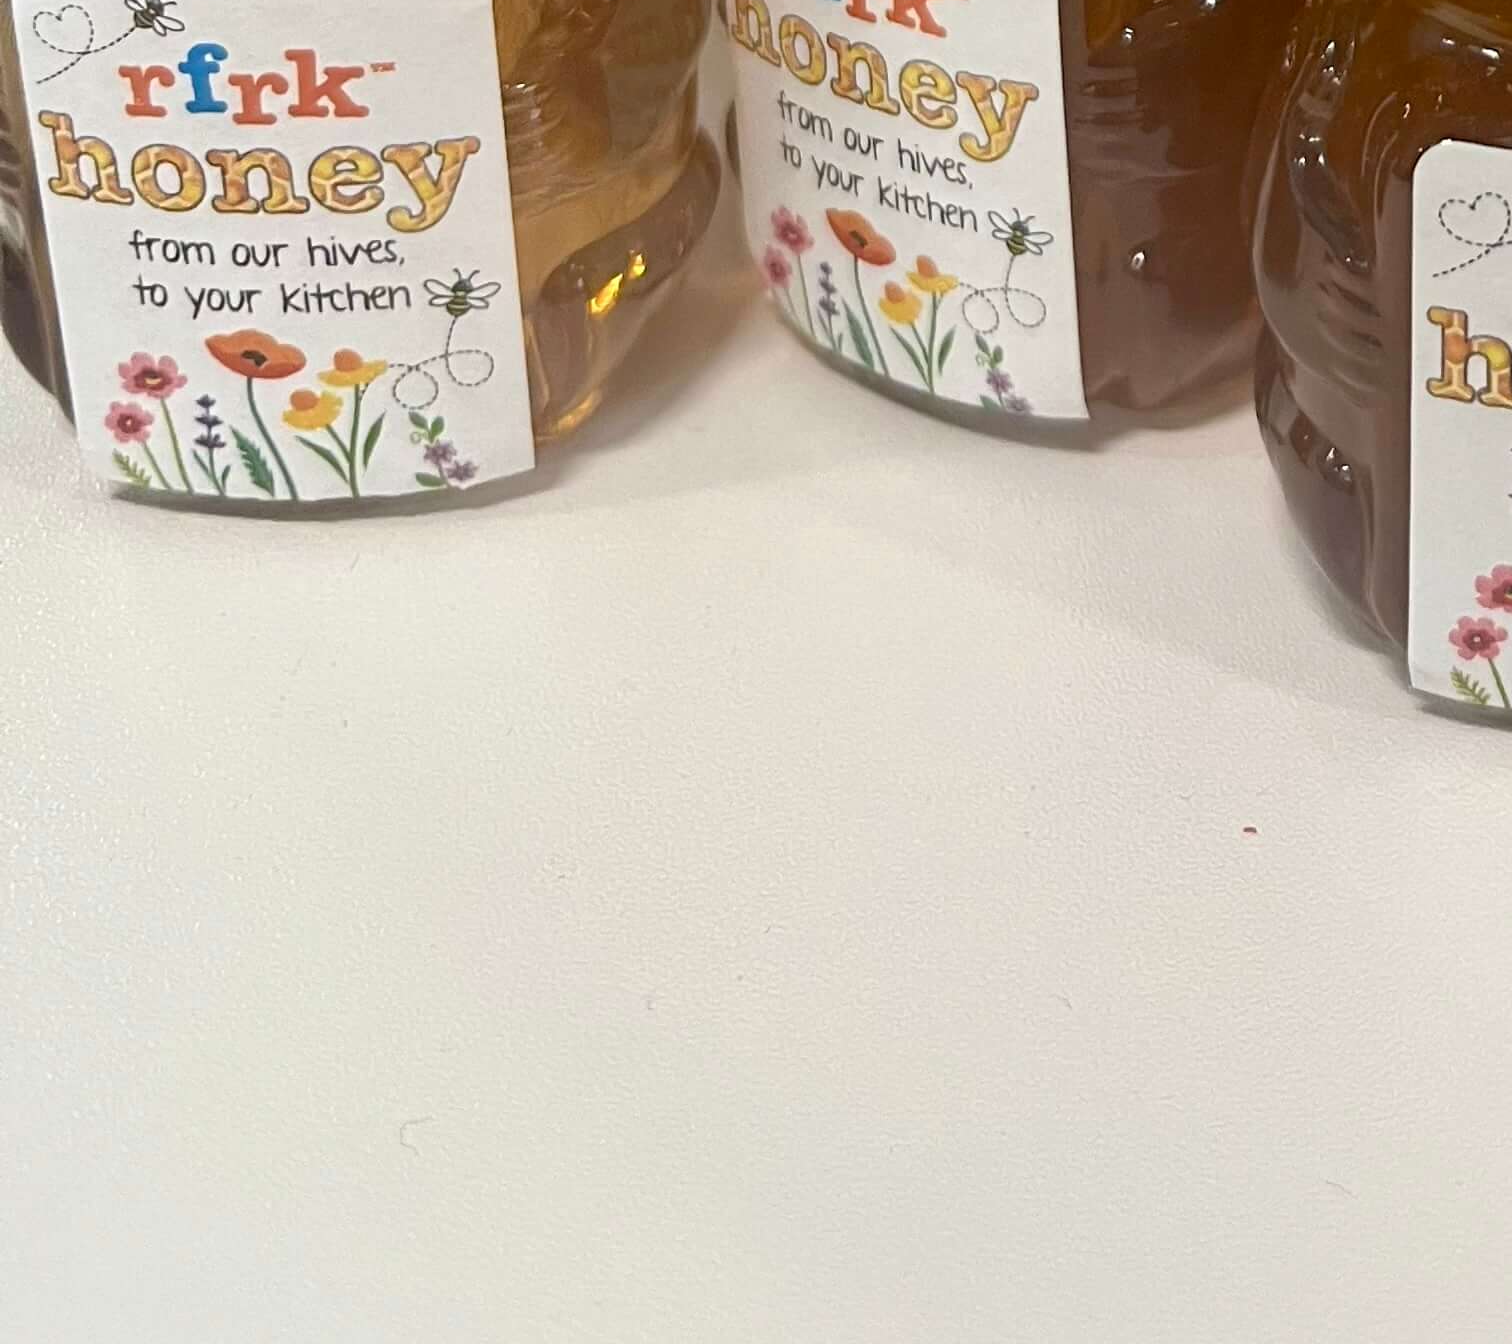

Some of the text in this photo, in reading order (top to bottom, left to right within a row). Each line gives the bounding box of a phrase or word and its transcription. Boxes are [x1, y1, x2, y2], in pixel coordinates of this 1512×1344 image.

[38, 109, 481, 233] honey
[778, 90, 974, 190] from our hives,
[780, 138, 979, 234] to your kitchen
[129, 230, 405, 268] from our hives,
[132, 275, 412, 318] to your kitchen
